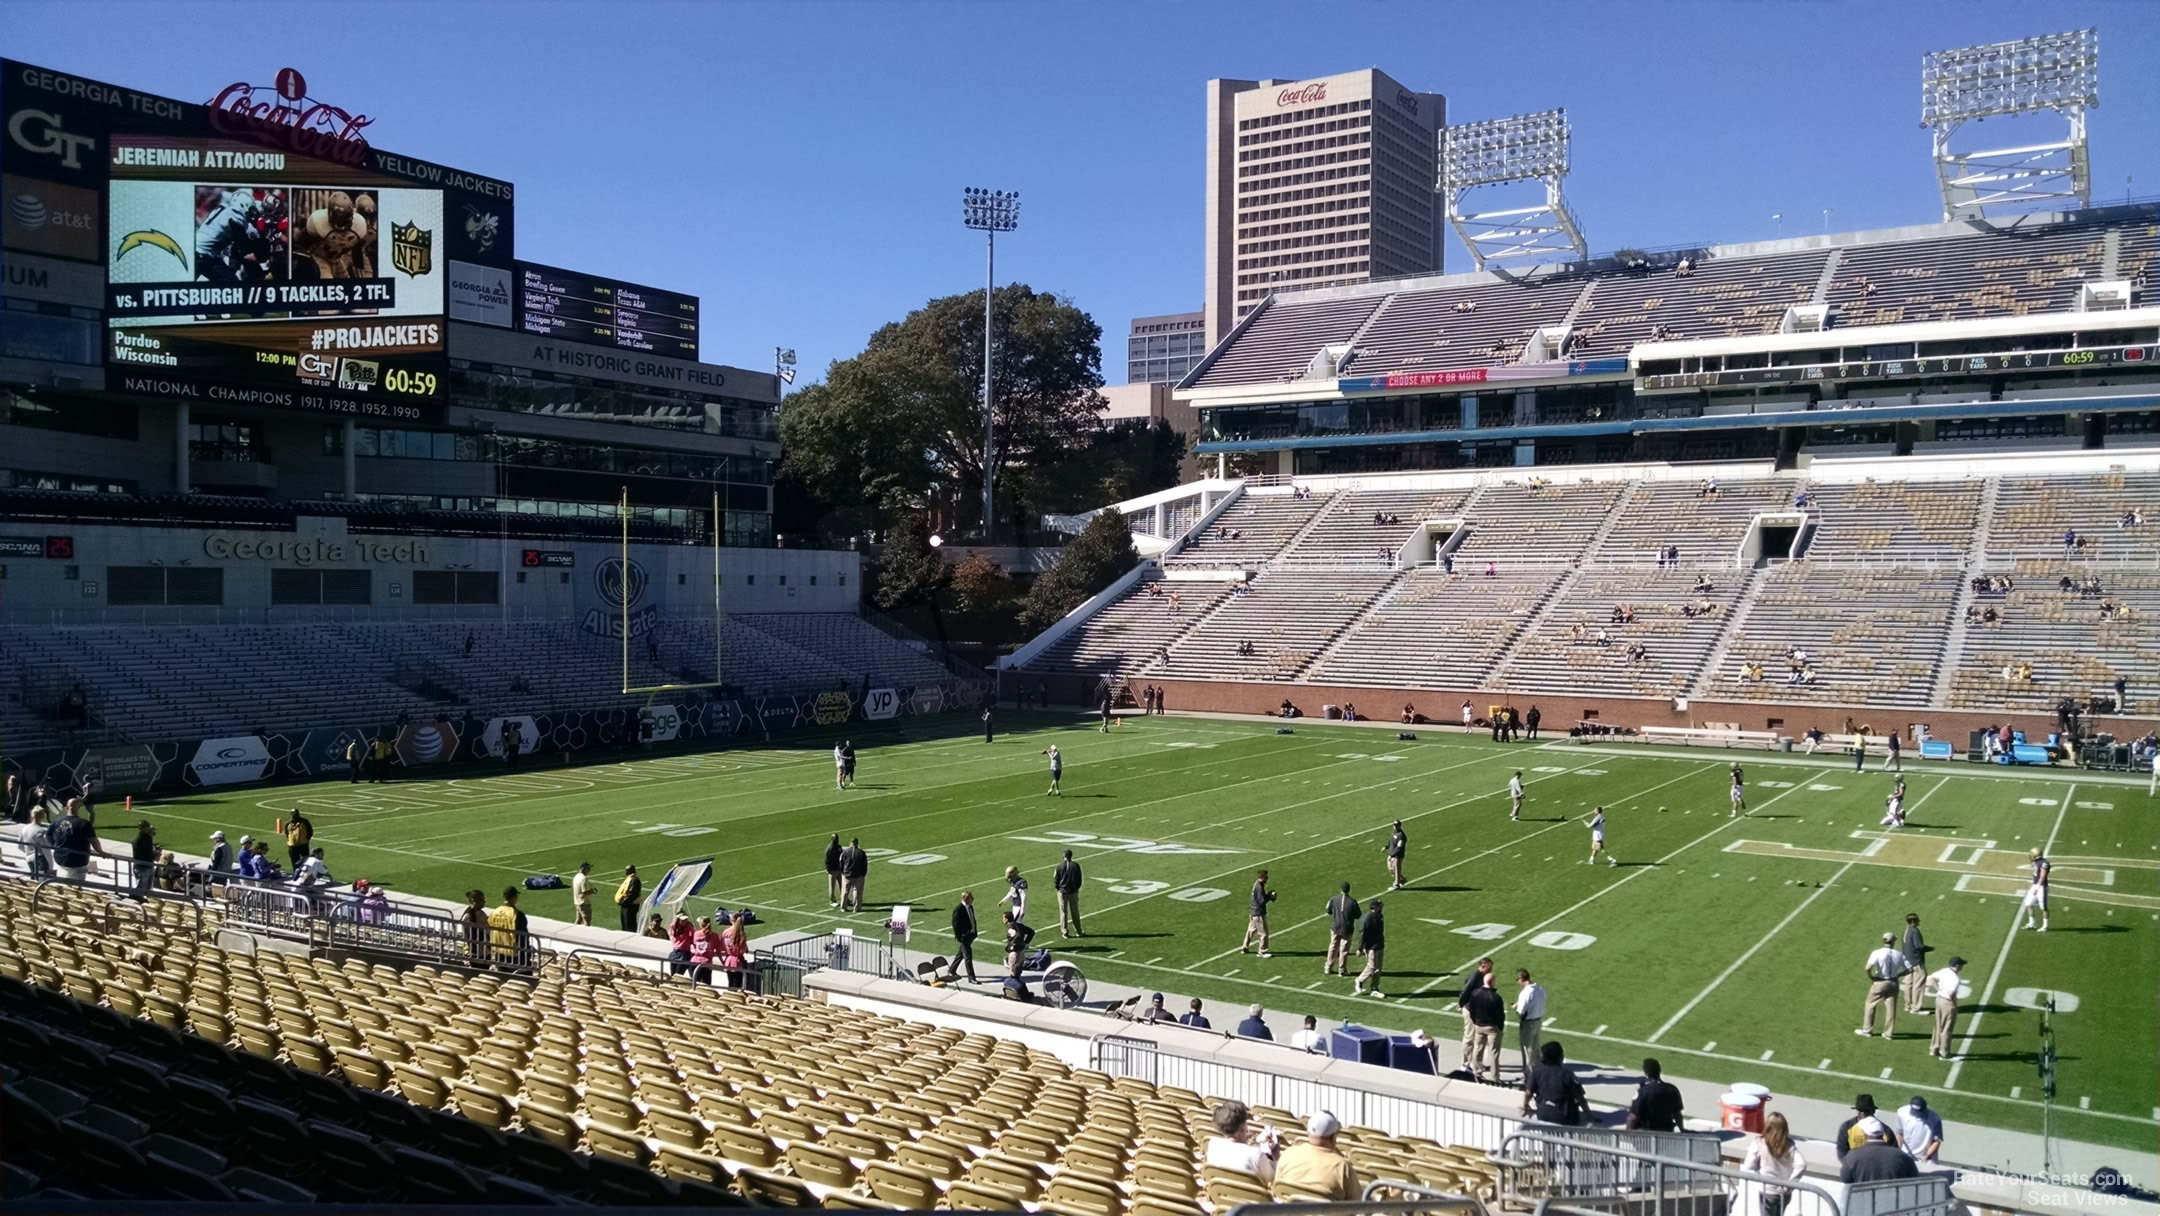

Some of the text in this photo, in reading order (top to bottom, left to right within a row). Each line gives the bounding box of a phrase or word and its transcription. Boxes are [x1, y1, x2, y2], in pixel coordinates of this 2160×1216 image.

[22, 68, 182, 121] GEORGIA TECH
[1277, 82, 1328, 107] Coca-Cola
[8, 108, 95, 169] GT
[113, 147, 286, 170] JEREMIAH ATTAOCHU
[376, 154, 512, 200] YELLOW JACKETS
[51, 210, 93, 230] at&t
[394, 243, 430, 271] NFL
[525, 271, 541, 281] Akron
[452, 280, 491, 294] GEORGIA
[525, 279, 548, 292] Bowling
[549, 283, 566, 293] Green
[143, 287, 244, 308] PITTSBURGH
[265, 287, 276, 303] 9
[280, 285, 350, 304] TACKLES,
[353, 285, 363, 300] 2
[366, 284, 390, 300] TFL
[478, 293, 509, 306] POWER
[547, 295, 560, 305] Tech
[617, 297, 632, 307] Texas
[525, 300, 544, 310] Miami
[525, 312, 566, 327] Michigan State
[525, 321, 551, 333] Michigan
[115, 331, 161, 349] Purdue
[311, 324, 439, 350] #PROJACKETS
[617, 337, 632, 347] South
[115, 347, 178, 366] Wisconsin
[256, 351, 297, 367] 12:00 PM
[2002, 360, 2008, 368] 0
[2025, 359, 2031, 367] 0
[2063, 352, 2094, 364] 60:59
[533, 346, 725, 388] AT HISTORIC GRANT FIELD
[1919, 365, 1925, 373] 0
[1943, 364, 1949, 372] 0
[385, 368, 437, 396] 60:59
[1389, 371, 1481, 386] CHOOSE ANY 2 OR MORE
[357, 383, 368, 392] AM
[125, 377, 200, 397] NATIONAL
[208, 386, 293, 406] CHAMPIONS
[393, 406, 420, 419] 1990
[199, 534, 429, 567] Georgia Tech
[873, 691, 892, 712] yp
[770, 708, 795, 716] DELTA
[1106, 879, 1232, 902] 30
[892, 921, 905, 929] BIG
[1449, 921, 1598, 951] 40
[1728, 1112, 1744, 1129] G
